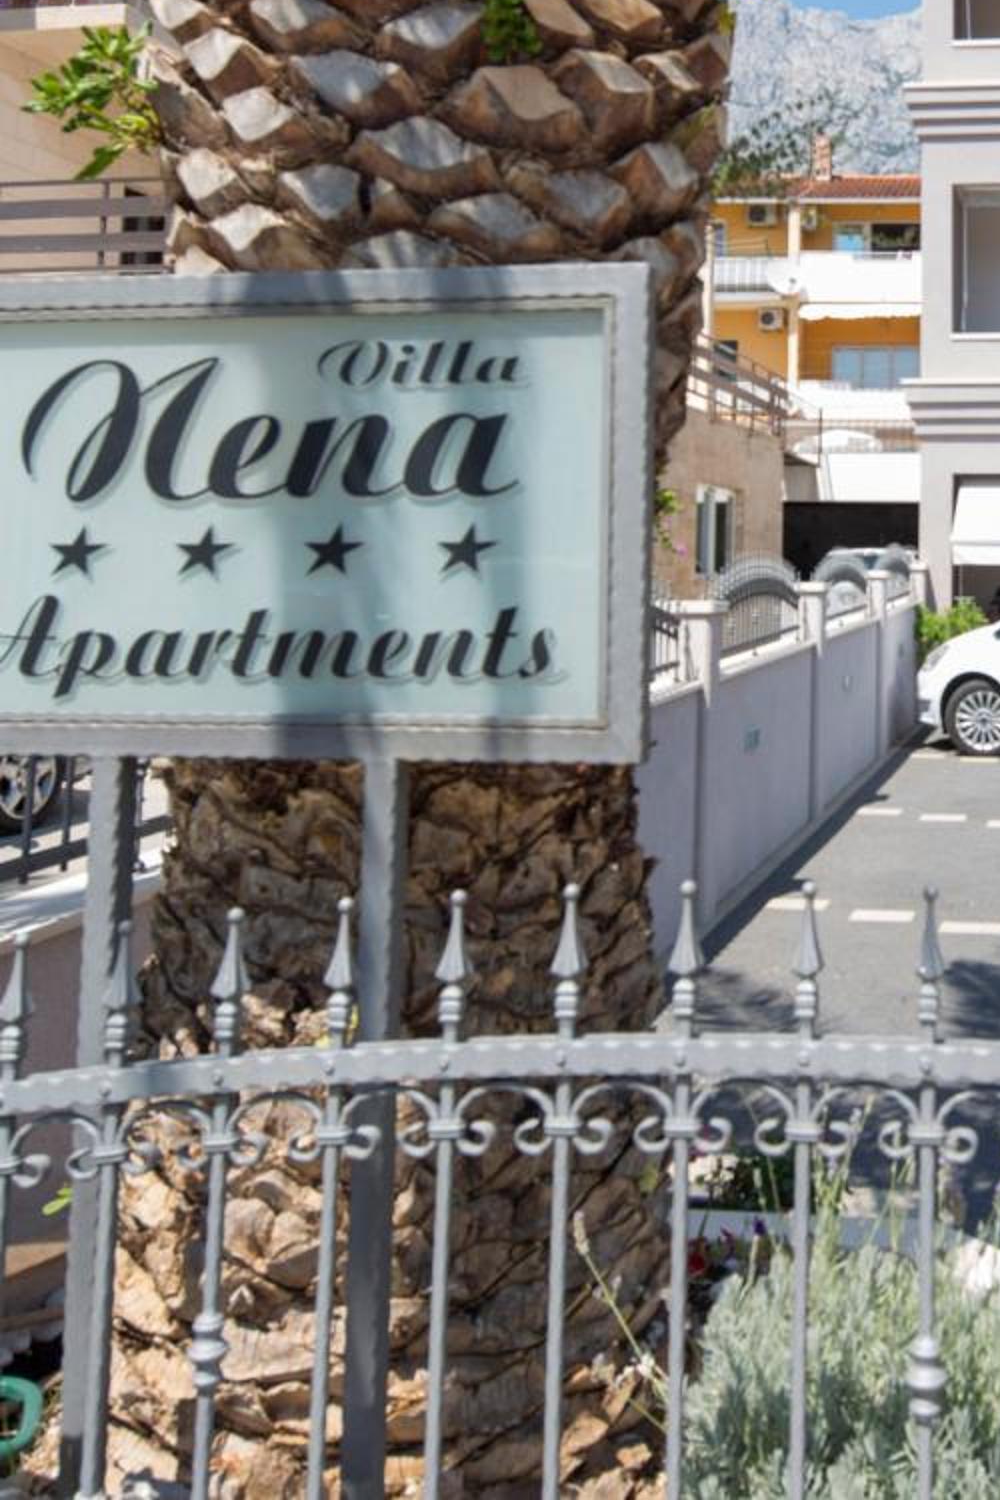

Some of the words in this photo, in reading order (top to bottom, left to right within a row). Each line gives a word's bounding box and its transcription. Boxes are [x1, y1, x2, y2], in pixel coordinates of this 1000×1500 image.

[317, 340, 521, 386] Villa
[21, 357, 520, 503] Nena
[0, 594, 556, 698] Apartments
